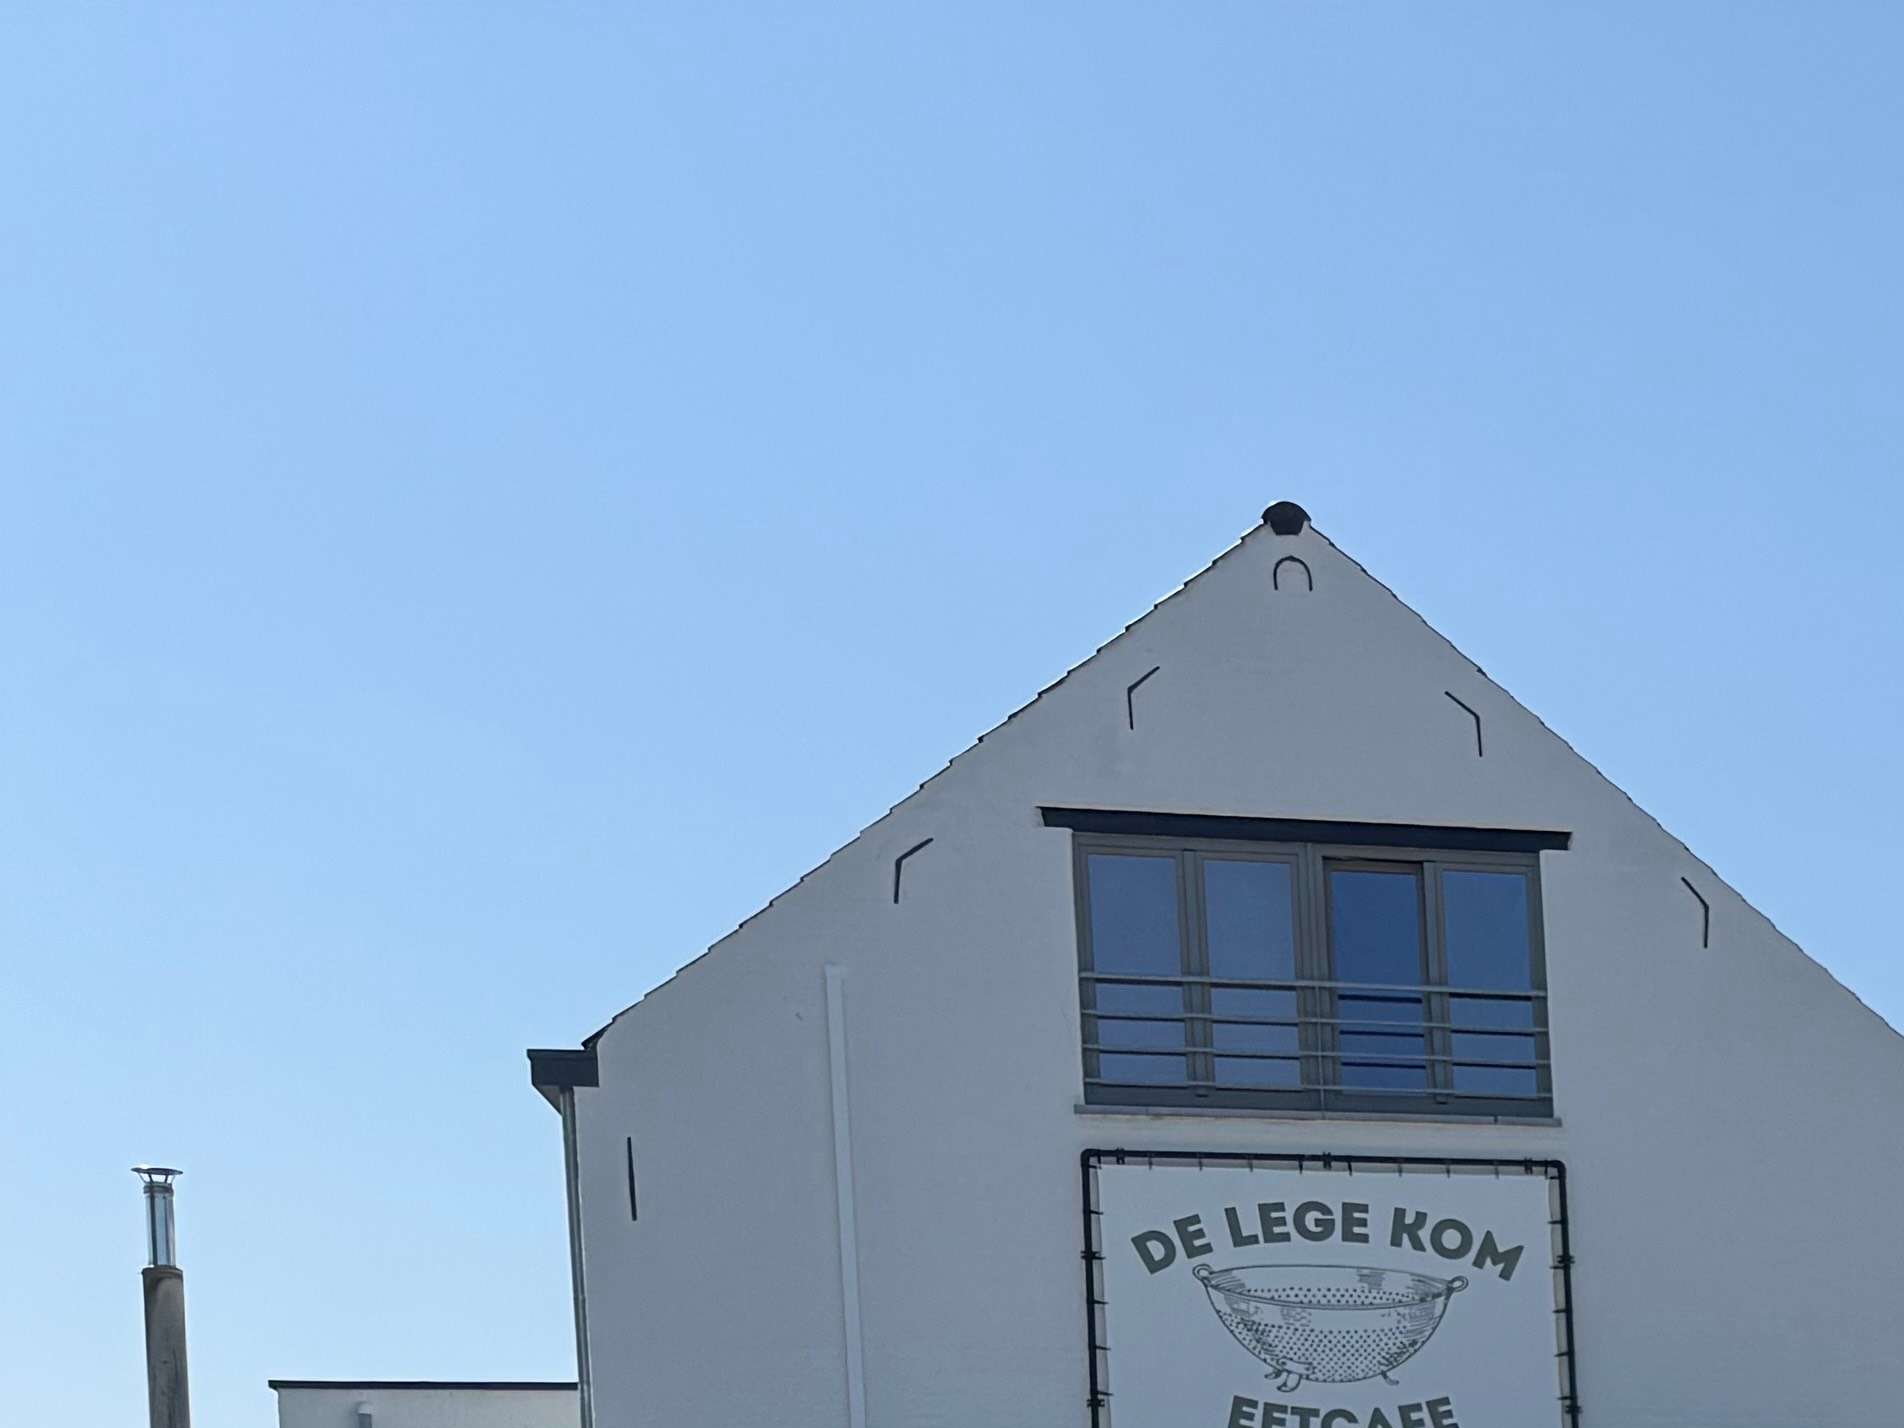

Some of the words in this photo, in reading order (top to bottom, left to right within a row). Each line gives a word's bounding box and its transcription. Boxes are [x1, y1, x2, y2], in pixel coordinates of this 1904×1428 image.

[1131, 1213, 1214, 1275] DE
[1224, 1201, 1370, 1248] LEGE
[1390, 1207, 1524, 1281] KOM
